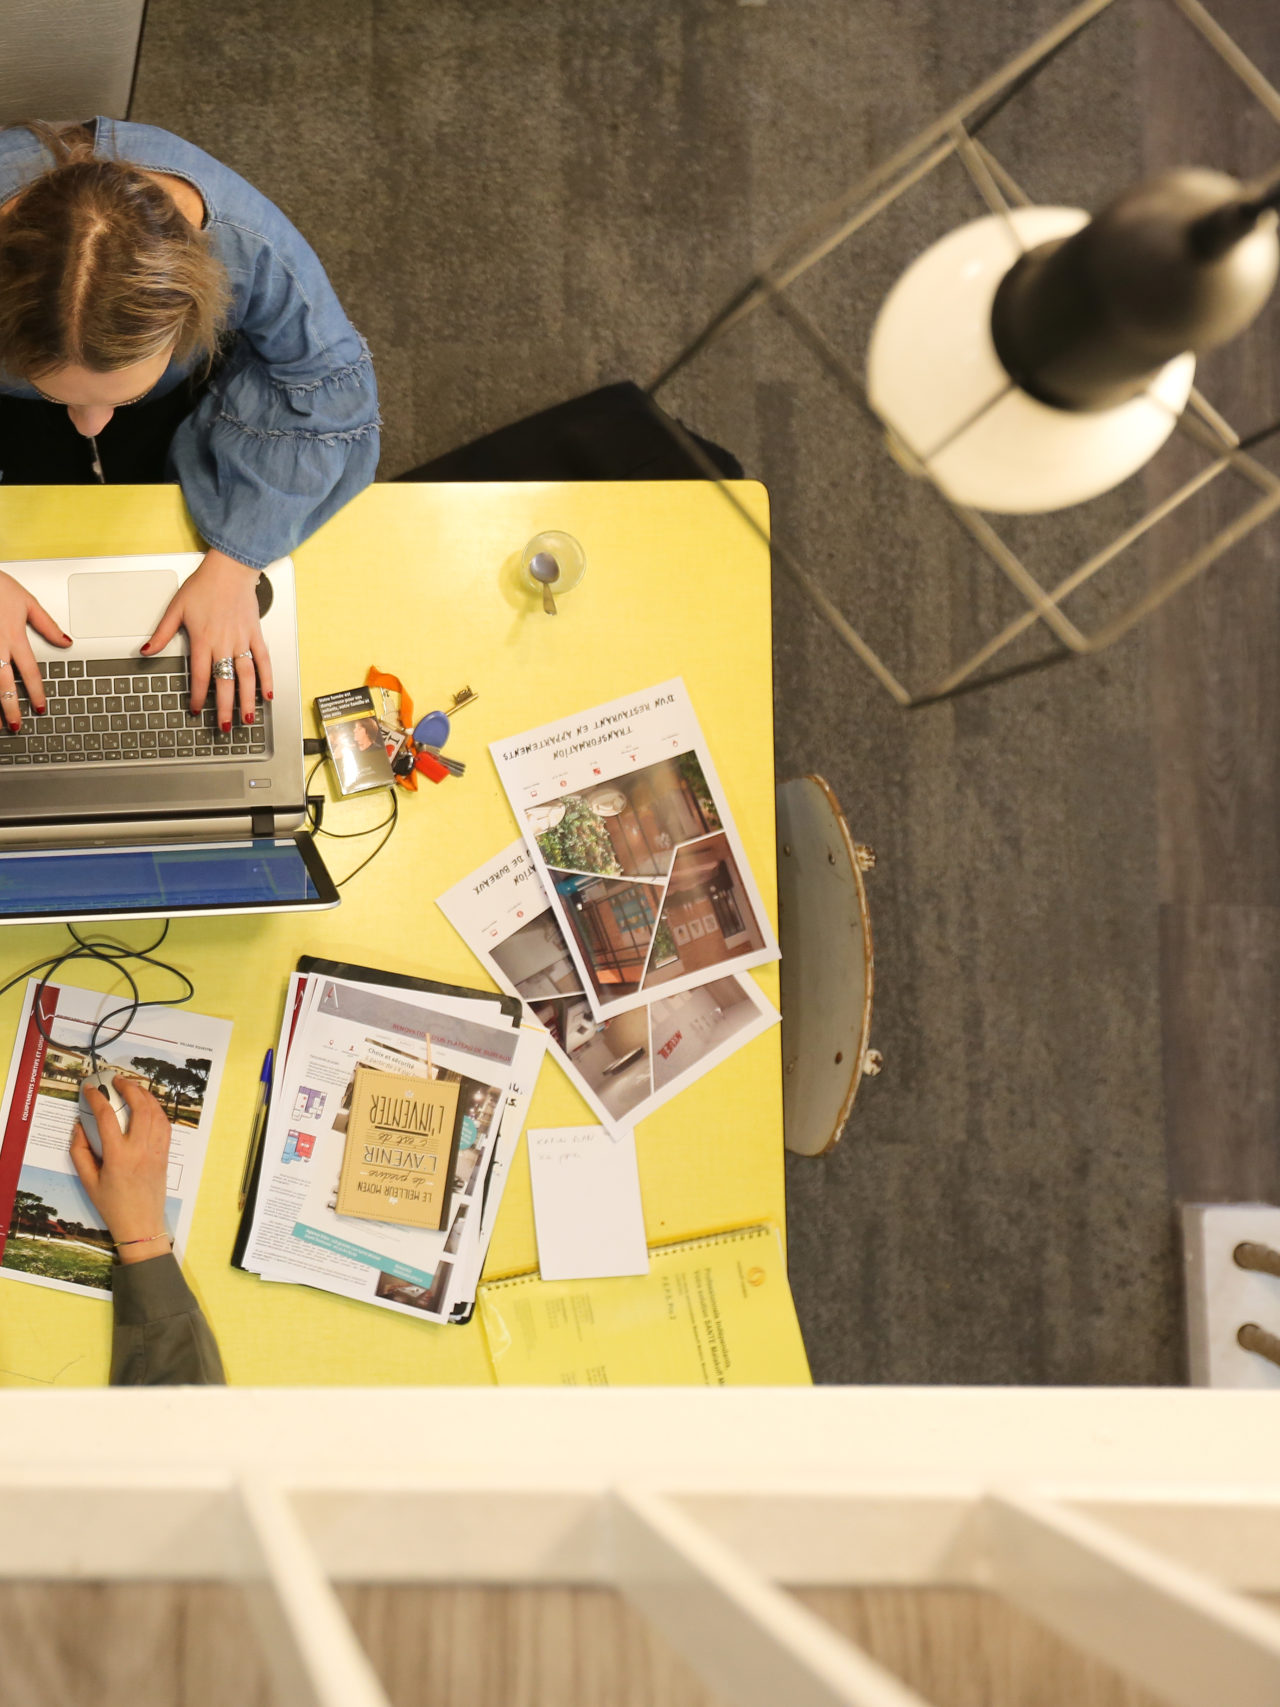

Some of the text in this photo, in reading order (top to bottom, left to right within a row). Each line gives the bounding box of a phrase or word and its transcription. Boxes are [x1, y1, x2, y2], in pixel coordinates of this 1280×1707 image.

[591, 701, 651, 730] RESTAURANT
[574, 723, 589, 736] EN
[501, 729, 573, 762] APPARTEMENTS
[471, 854, 524, 895] DE BUREAUX
[21, 1082, 35, 1121] EQUIPEMENTS
[29, 1057, 40, 1083] SPORTIFS
[367, 1094, 444, 1137] L'INVENTER
[377, 1132, 392, 1144] de
[362, 1145, 437, 1171] L'AVENIR
[366, 1164, 425, 1188] de prédire
[356, 1181, 432, 1203] LE MEILLEUR MOYEN
